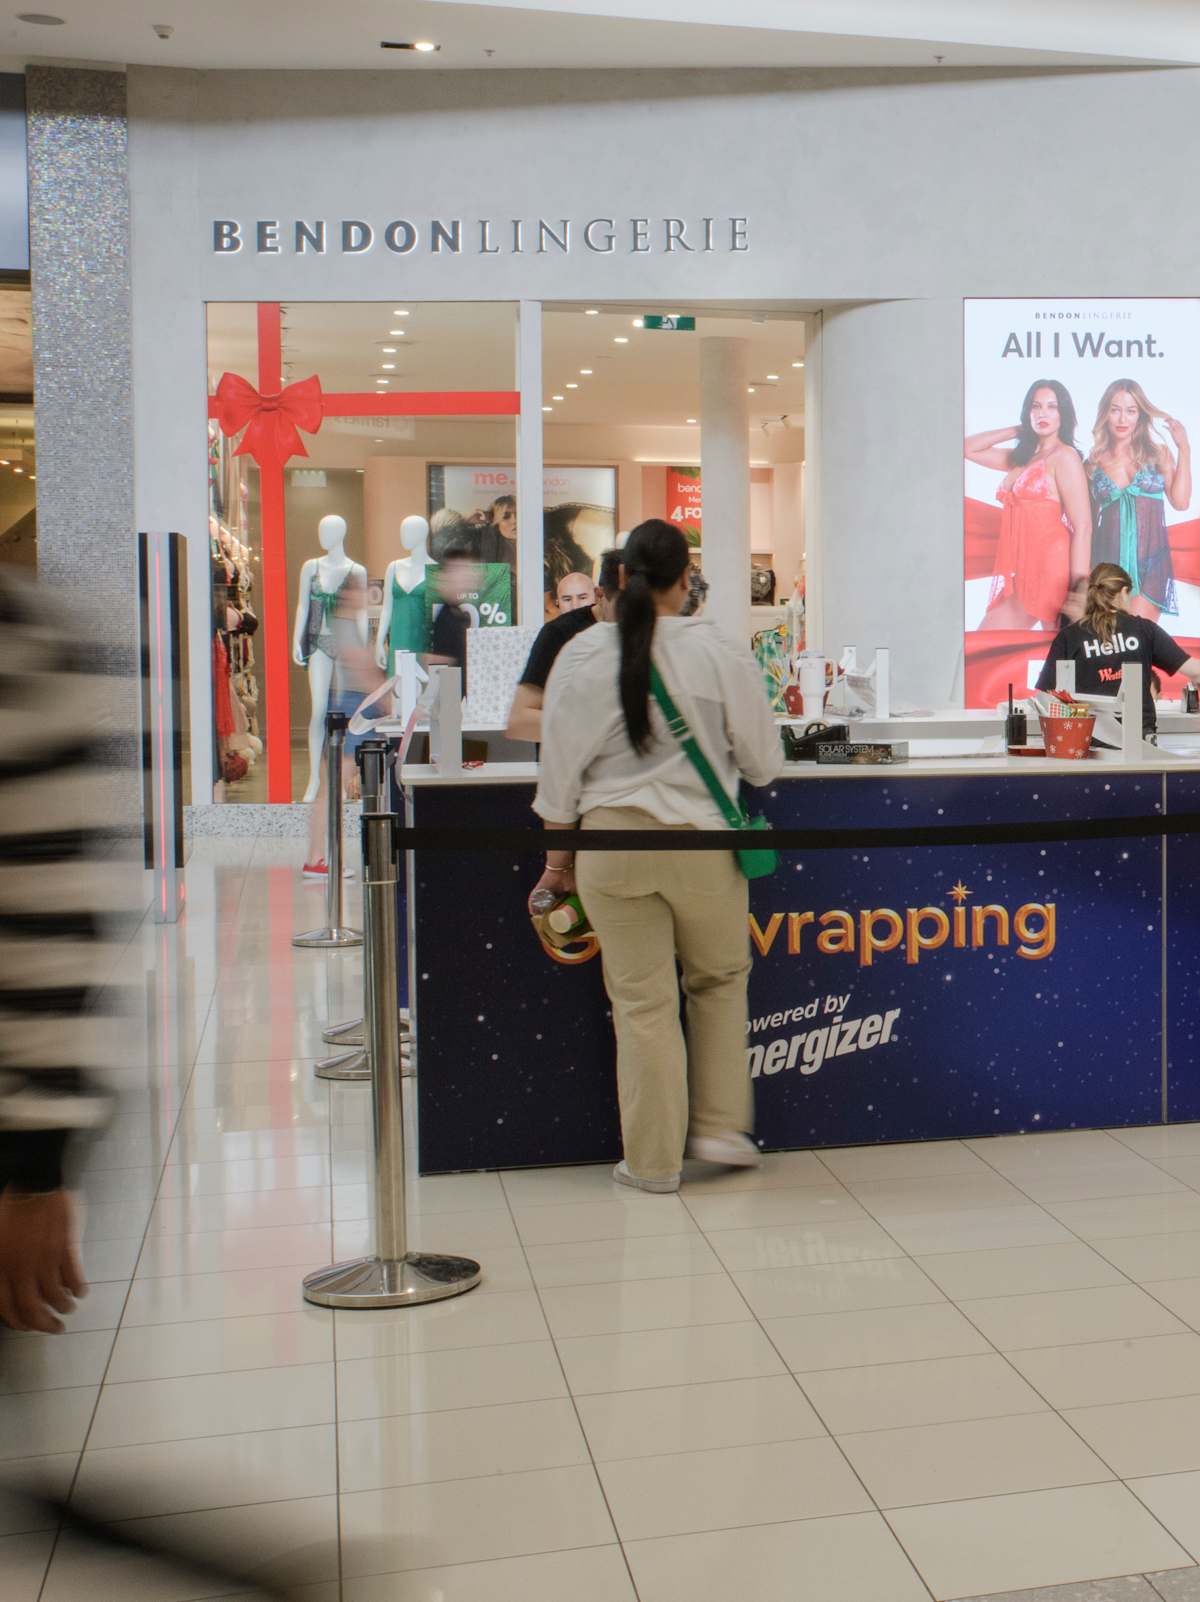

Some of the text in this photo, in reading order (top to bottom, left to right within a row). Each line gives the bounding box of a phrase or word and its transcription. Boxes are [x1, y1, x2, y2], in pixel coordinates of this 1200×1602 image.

[1001, 331, 1164, 358] All I Want.
[671, 505, 702, 522] 4 FO
[468, 592, 479, 600] TO
[1083, 632, 1140, 659] Hello
[818, 743, 874, 754] SOLAR SYSTEM
[745, 992, 851, 1036] owered by
[746, 1007, 900, 1080] nergizer
